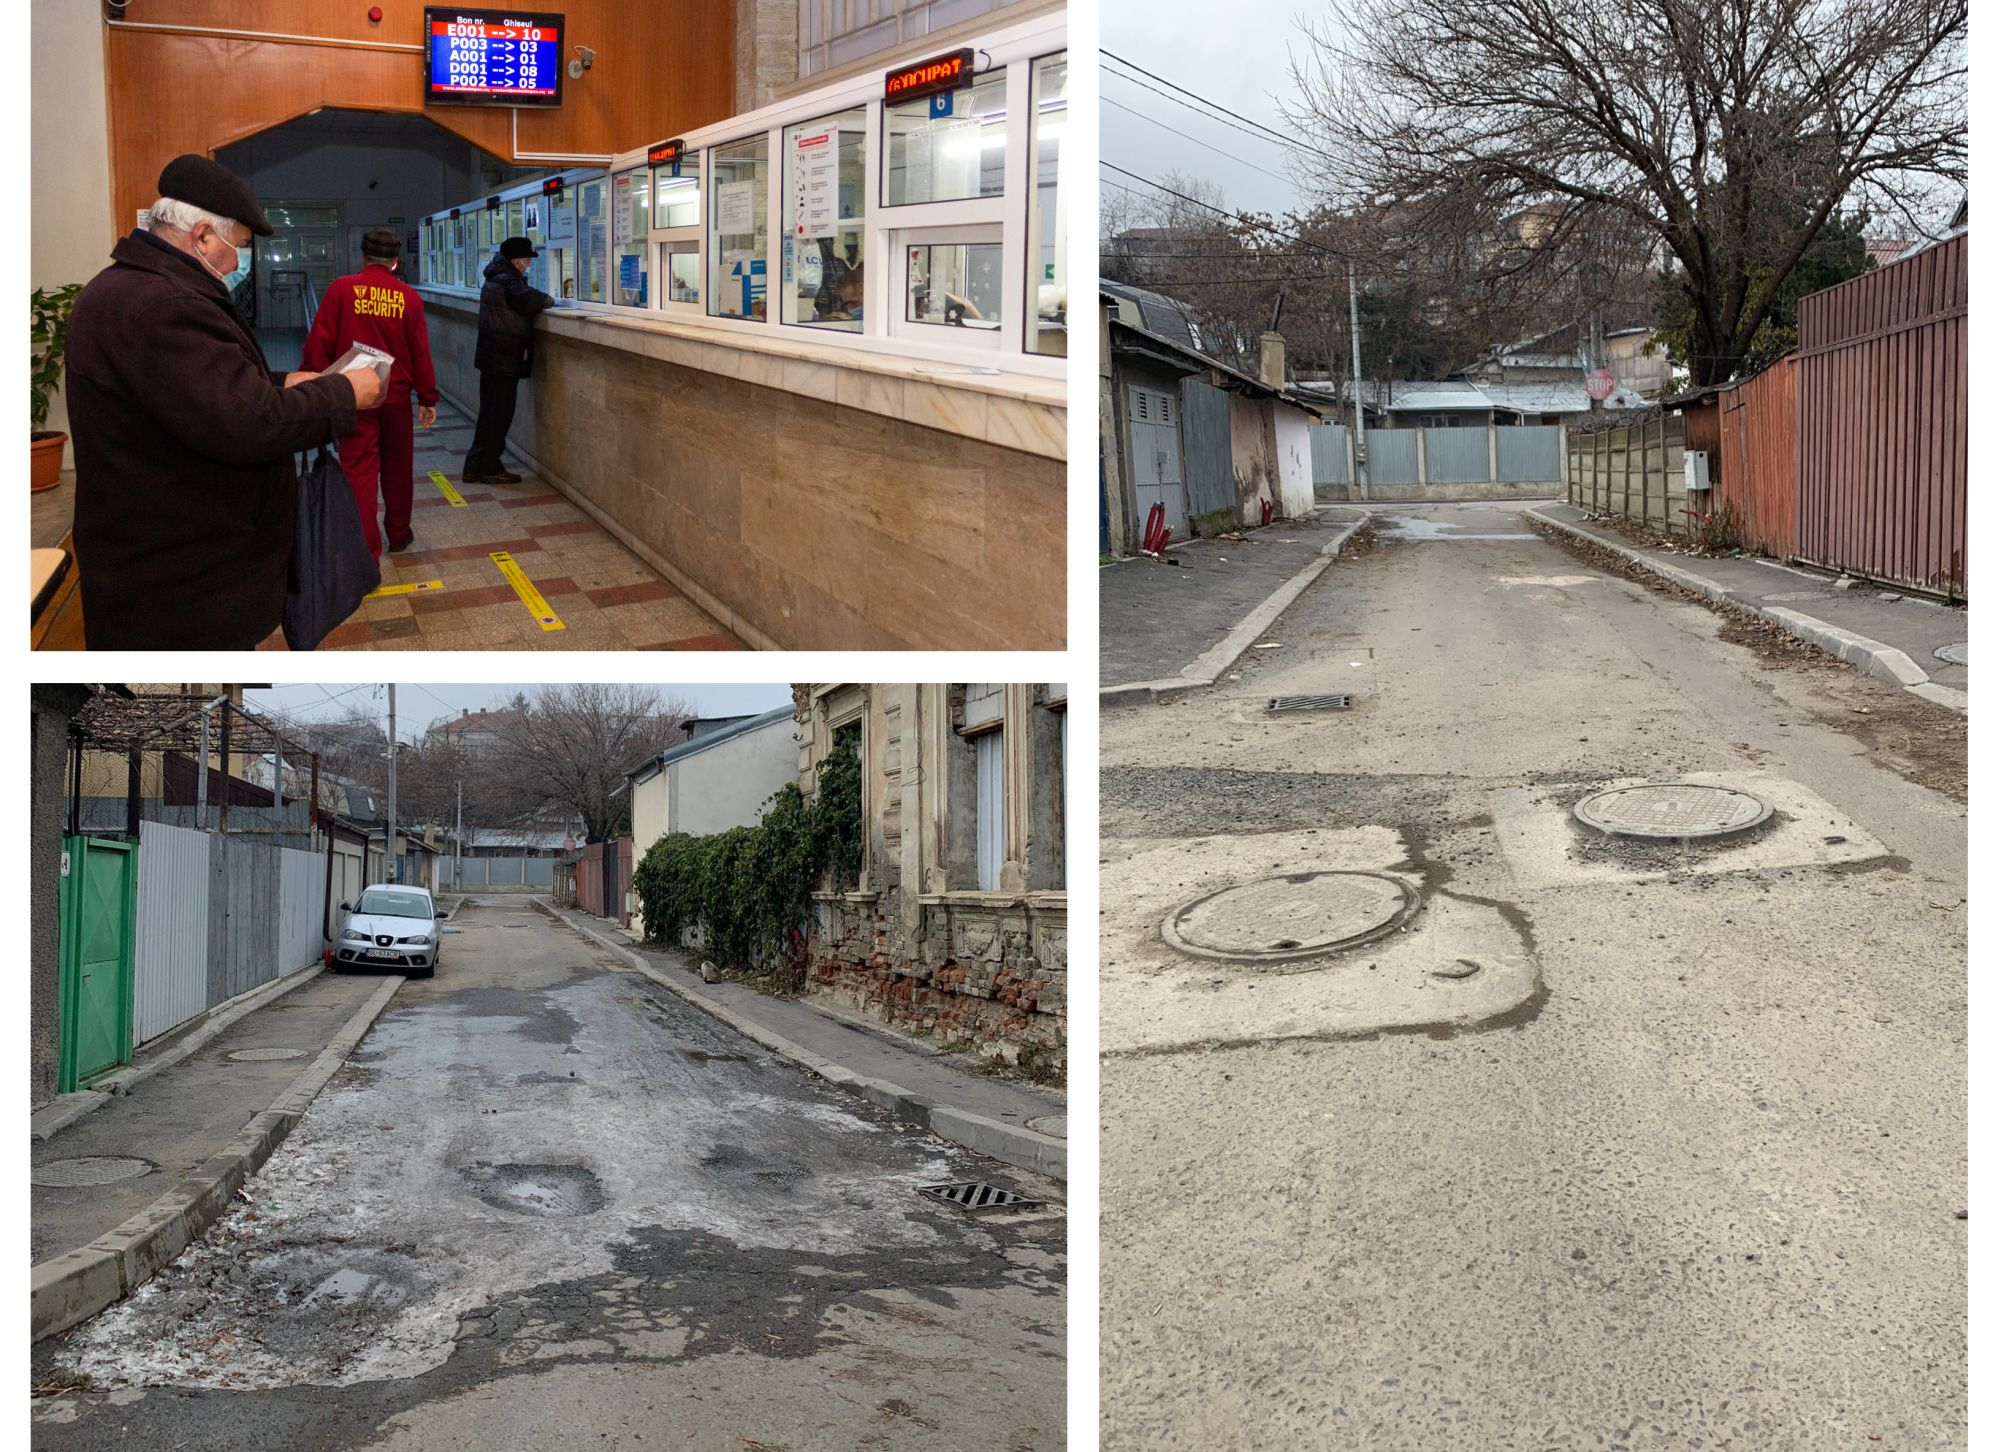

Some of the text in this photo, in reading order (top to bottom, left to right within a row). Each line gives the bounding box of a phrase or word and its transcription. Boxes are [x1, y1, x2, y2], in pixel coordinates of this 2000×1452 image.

[456, 16, 472, 25] Bon
[447, 24, 487, 37] E001
[522, 29, 541, 41] 10
[450, 37, 488, 50] P003
[519, 41, 538, 52] 03
[449, 50, 488, 63] A001
[519, 54, 537, 65] 01
[450, 62, 488, 75] D001
[519, 66, 538, 77] 08
[450, 75, 487, 87] P002
[518, 78, 537, 89] 05
[936, 93, 946, 111] 6
[370, 286, 405, 305] DIALFA
[354, 299, 405, 319] SECURITY
[1587, 378, 1613, 391] STOP
